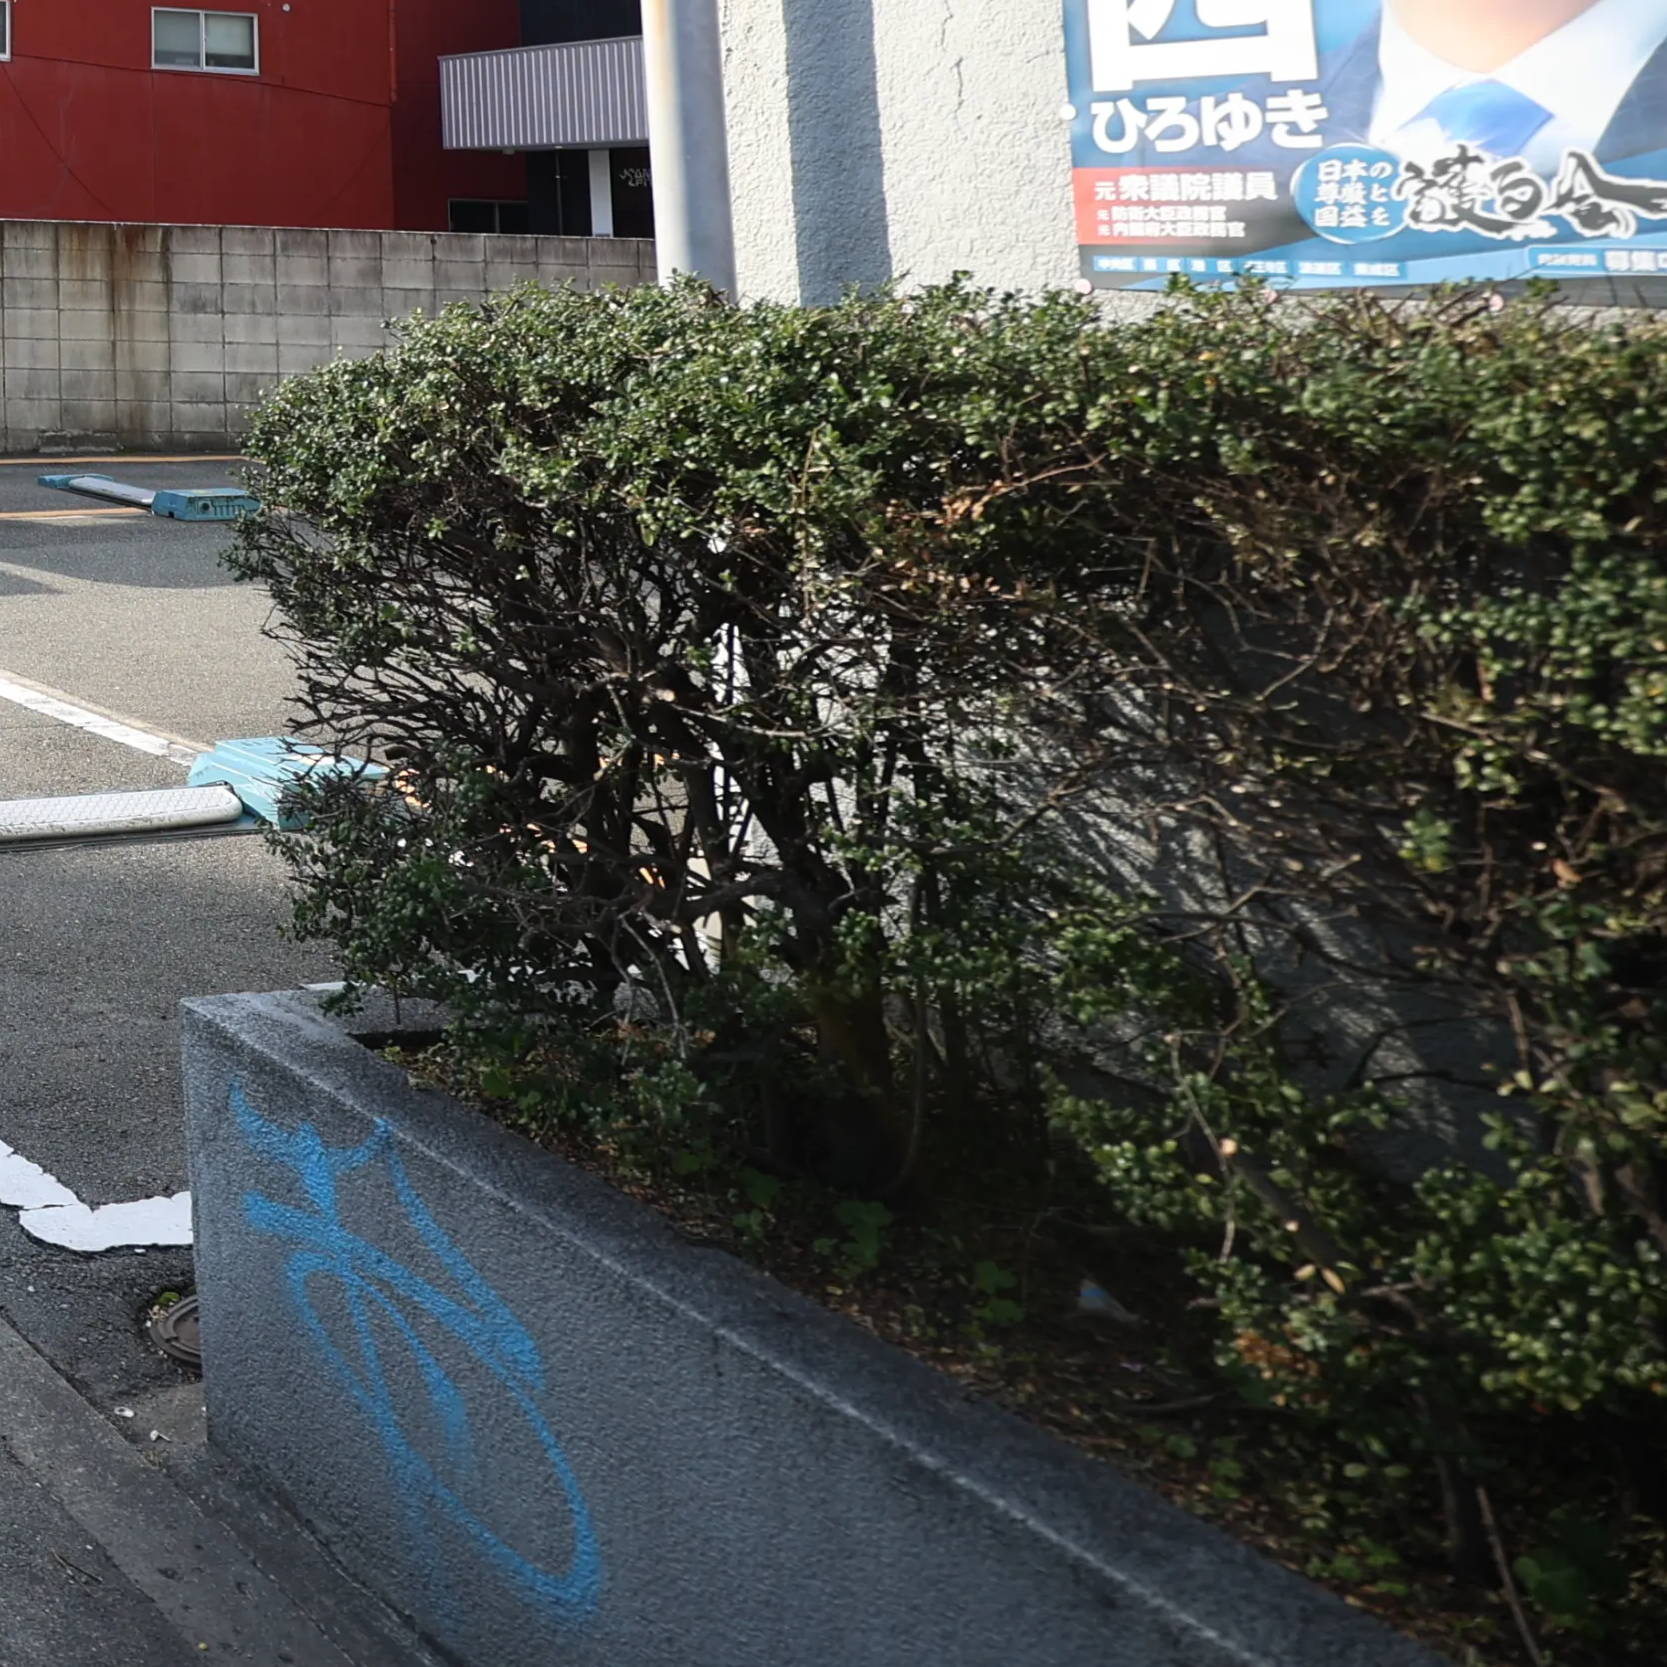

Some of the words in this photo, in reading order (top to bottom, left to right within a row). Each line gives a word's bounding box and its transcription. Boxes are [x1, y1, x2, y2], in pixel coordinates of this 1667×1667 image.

[1091, 89, 1328, 154] ひろゆき
[1318, 158, 1393, 183] 日本の
